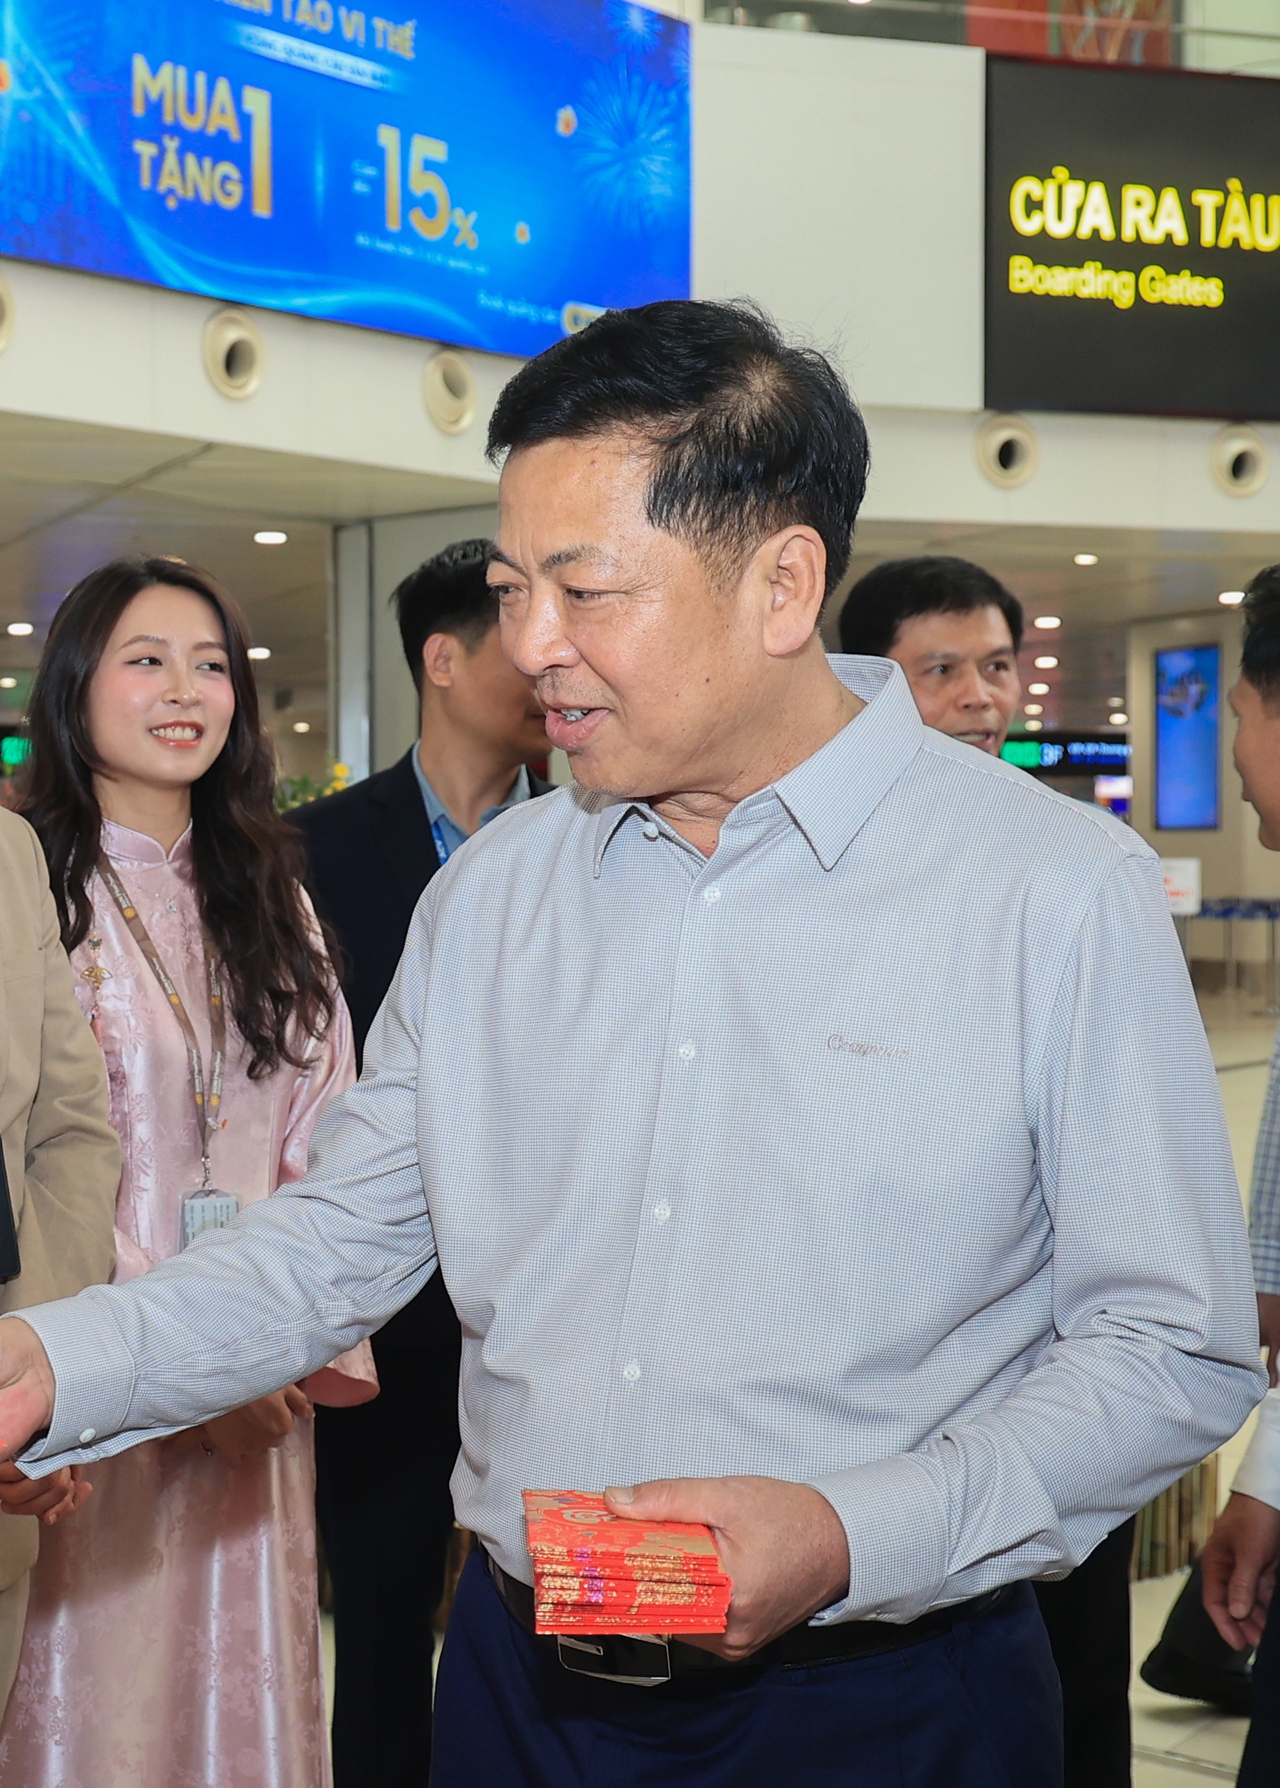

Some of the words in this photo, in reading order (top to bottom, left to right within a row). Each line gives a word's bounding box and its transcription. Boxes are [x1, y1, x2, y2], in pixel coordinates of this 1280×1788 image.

[371, 15, 418, 61] THẾ
[132, 53, 242, 143] MUA
[132, 133, 244, 211] TẶNG
[241, 84, 273, 219] 1
[1009, 165, 1117, 241] CỬA
[1121, 183, 1190, 246] RA
[1191, 177, 1280, 252] TÀU
[1008, 255, 1136, 310] Boarding
[1138, 264, 1225, 308] Gates
